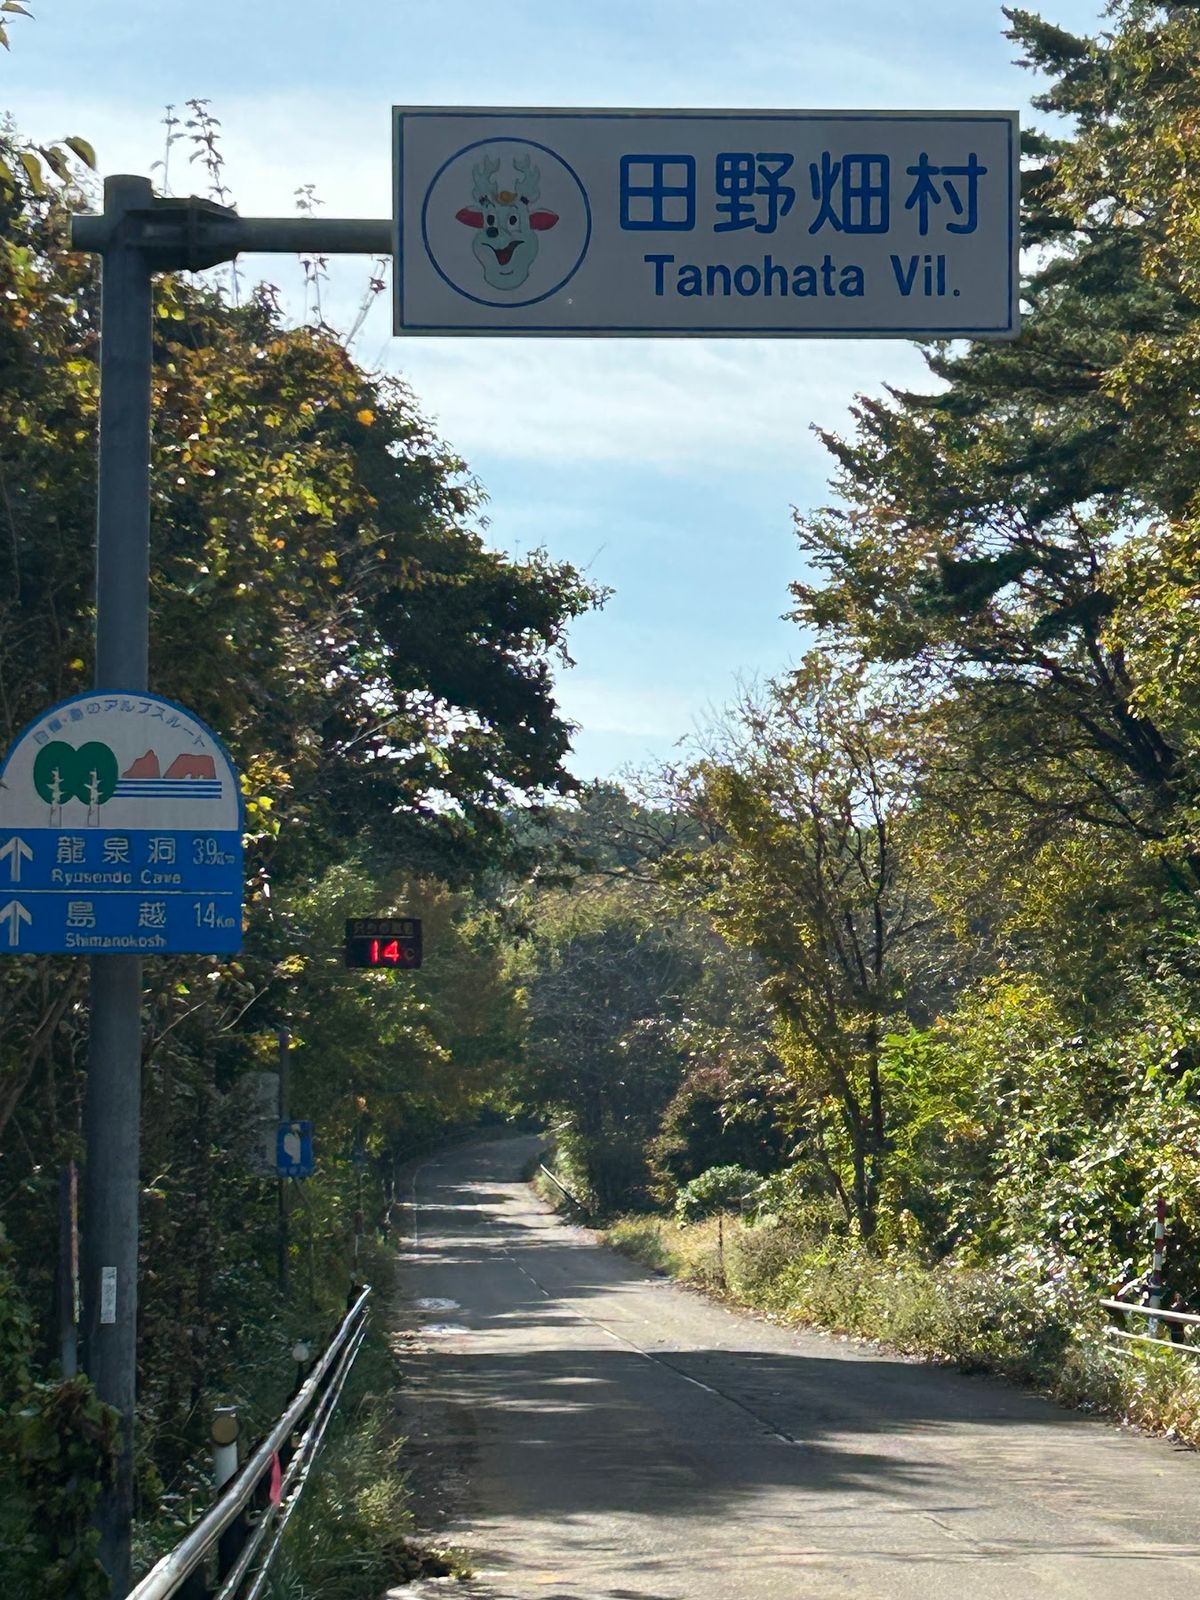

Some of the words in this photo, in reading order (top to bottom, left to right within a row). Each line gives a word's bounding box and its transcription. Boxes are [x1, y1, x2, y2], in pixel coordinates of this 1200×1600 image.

[619, 151, 988, 236] 田野畑村
[643, 254, 866, 298] Tanohata
[889, 254, 962, 298] Vil.
[55, 836, 177, 865] 龍泉洞
[140, 869, 182, 884] Cave
[66, 901, 168, 929] 島越
[370, 938, 400, 963] 14
